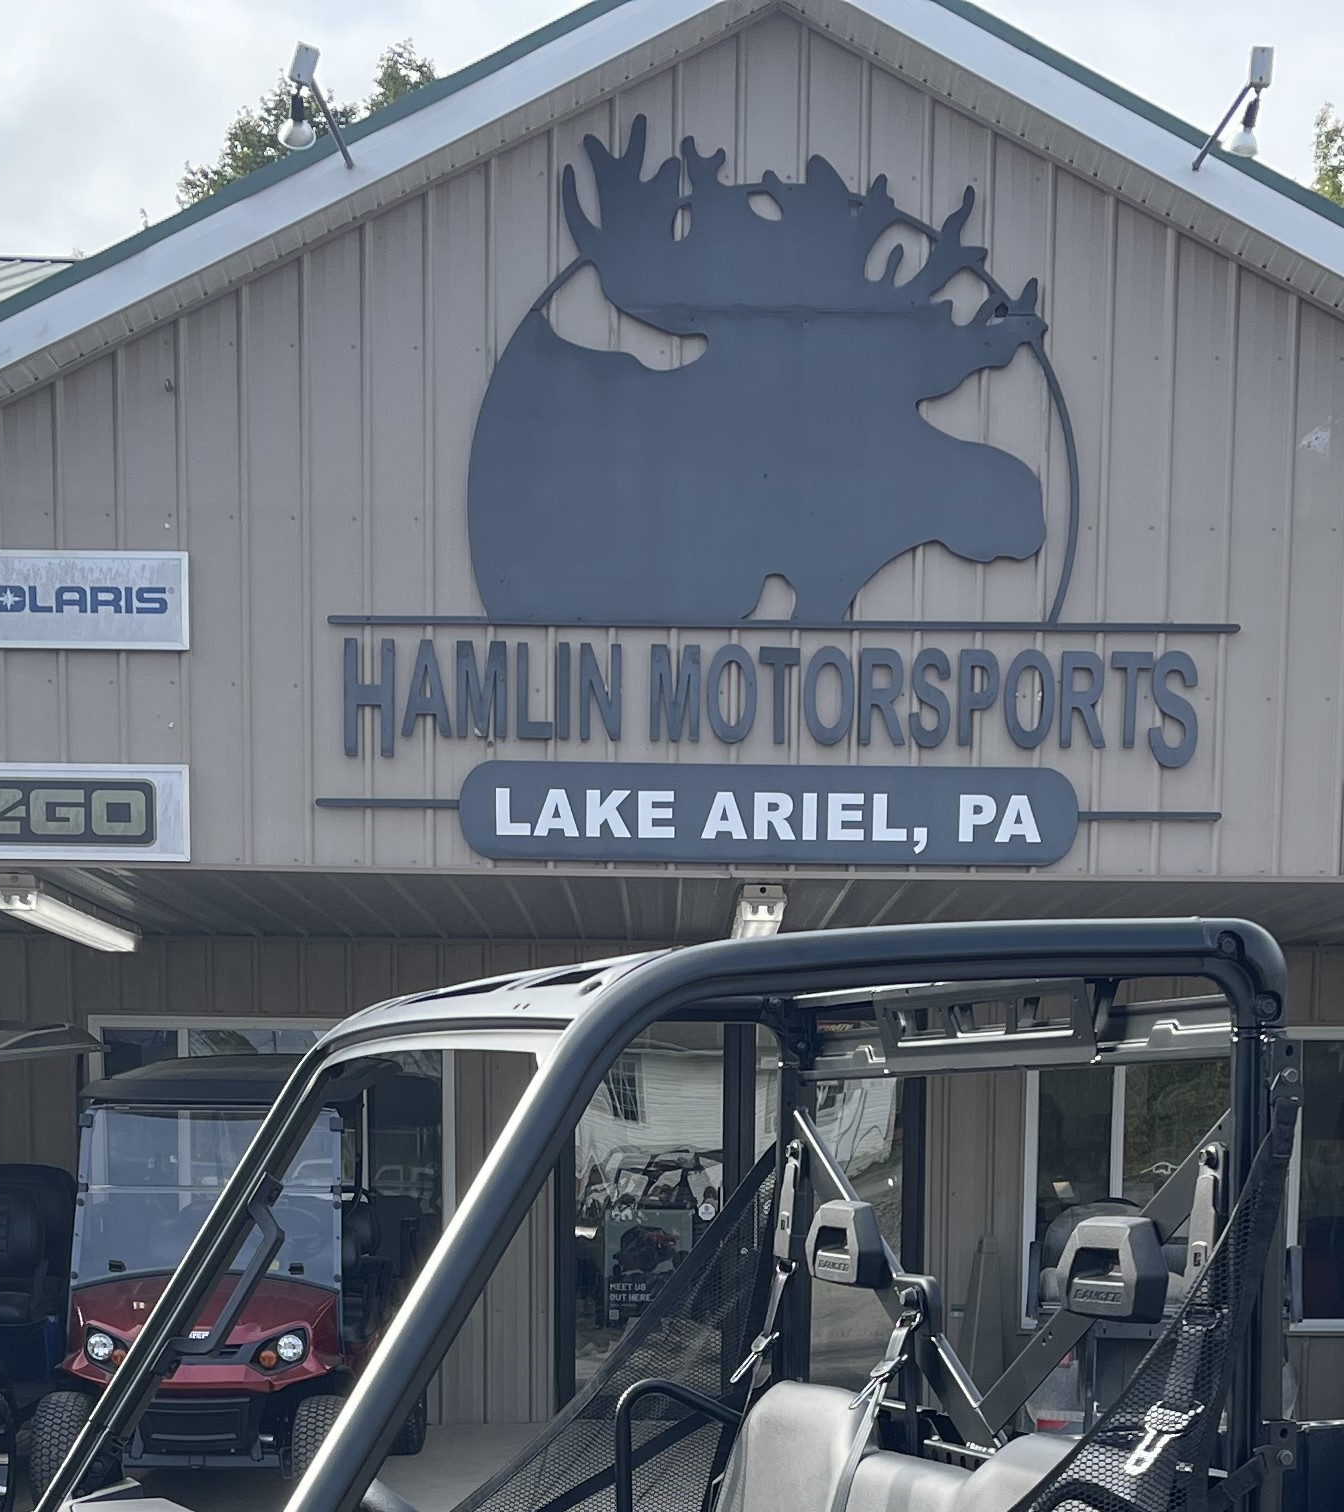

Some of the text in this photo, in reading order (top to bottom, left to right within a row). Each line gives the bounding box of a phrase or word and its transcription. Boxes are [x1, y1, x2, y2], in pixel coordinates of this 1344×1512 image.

[342, 636, 1199, 769] HAMLIN MOTORSPORTS
[494, 787, 1042, 855] LAKE ARIEL, PA
[609, 1282, 647, 1291] MEET US
[609, 1293, 627, 1301] OUT
